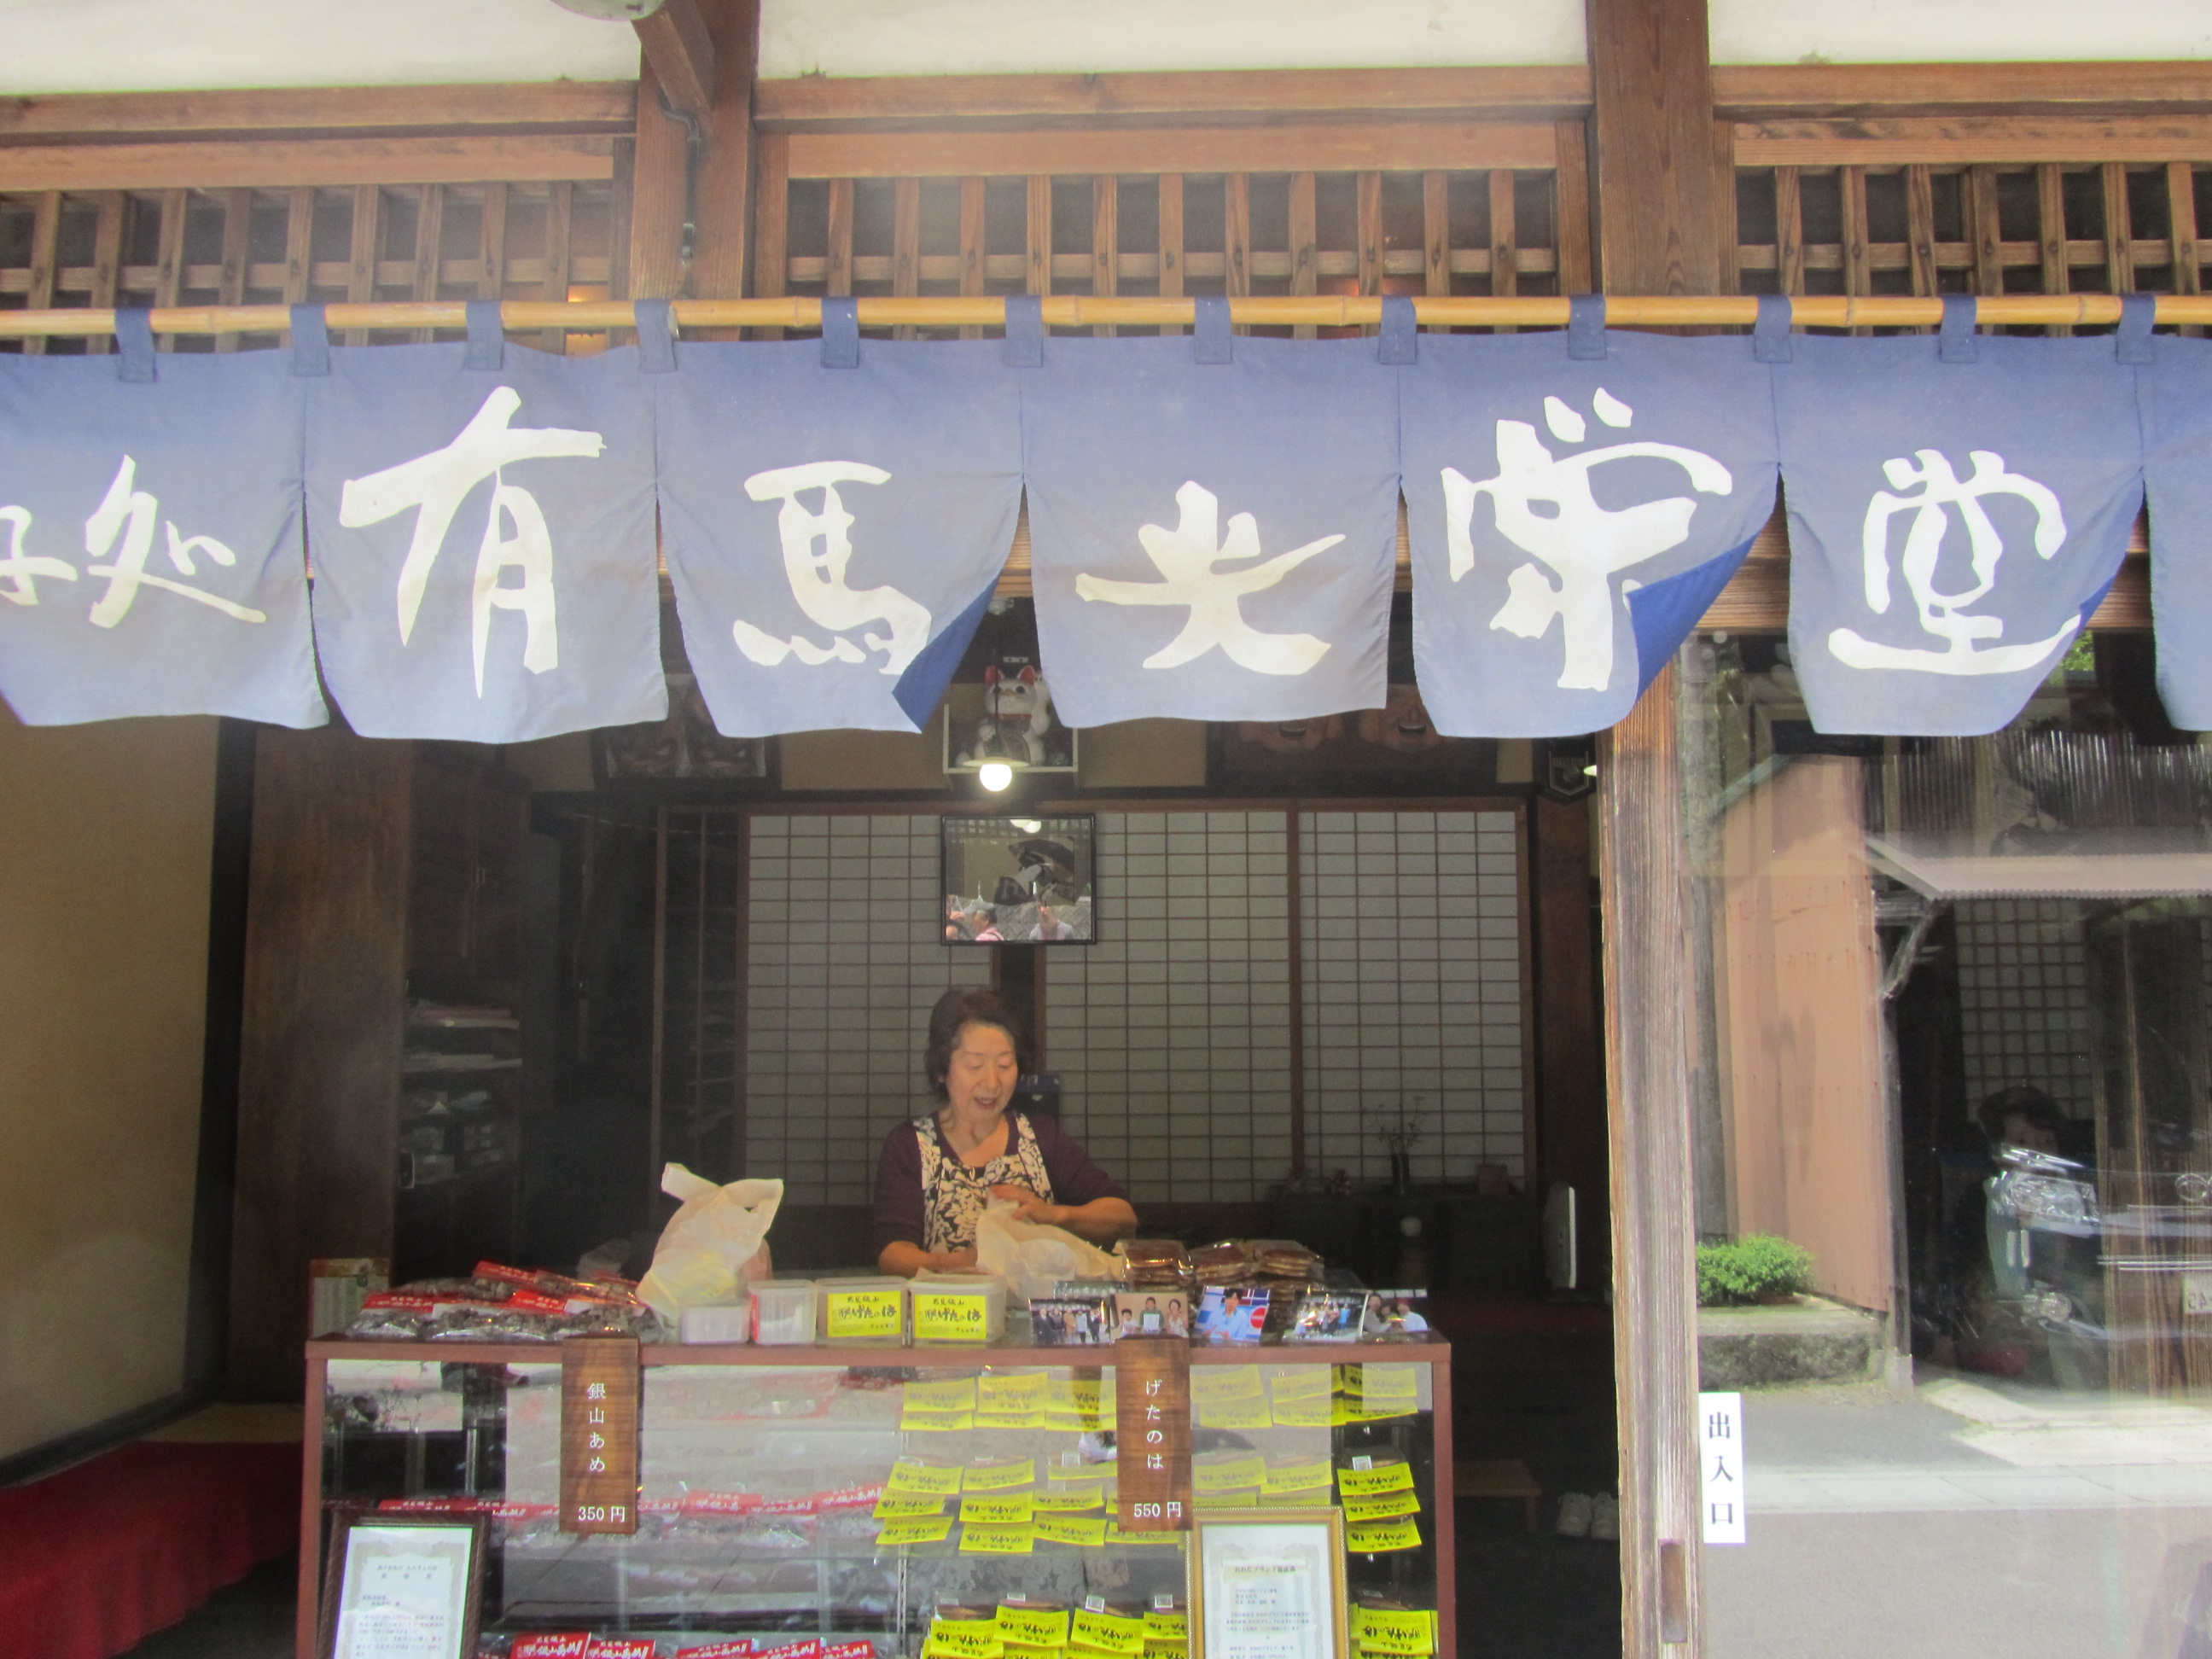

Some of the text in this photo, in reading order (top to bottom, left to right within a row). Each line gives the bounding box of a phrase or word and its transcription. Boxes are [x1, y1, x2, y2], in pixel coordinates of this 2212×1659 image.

[586, 1382, 607, 1473] 銀山あめ
[1145, 1378, 1164, 1470] げたのは
[1708, 1412, 1733, 1525] 出入口
